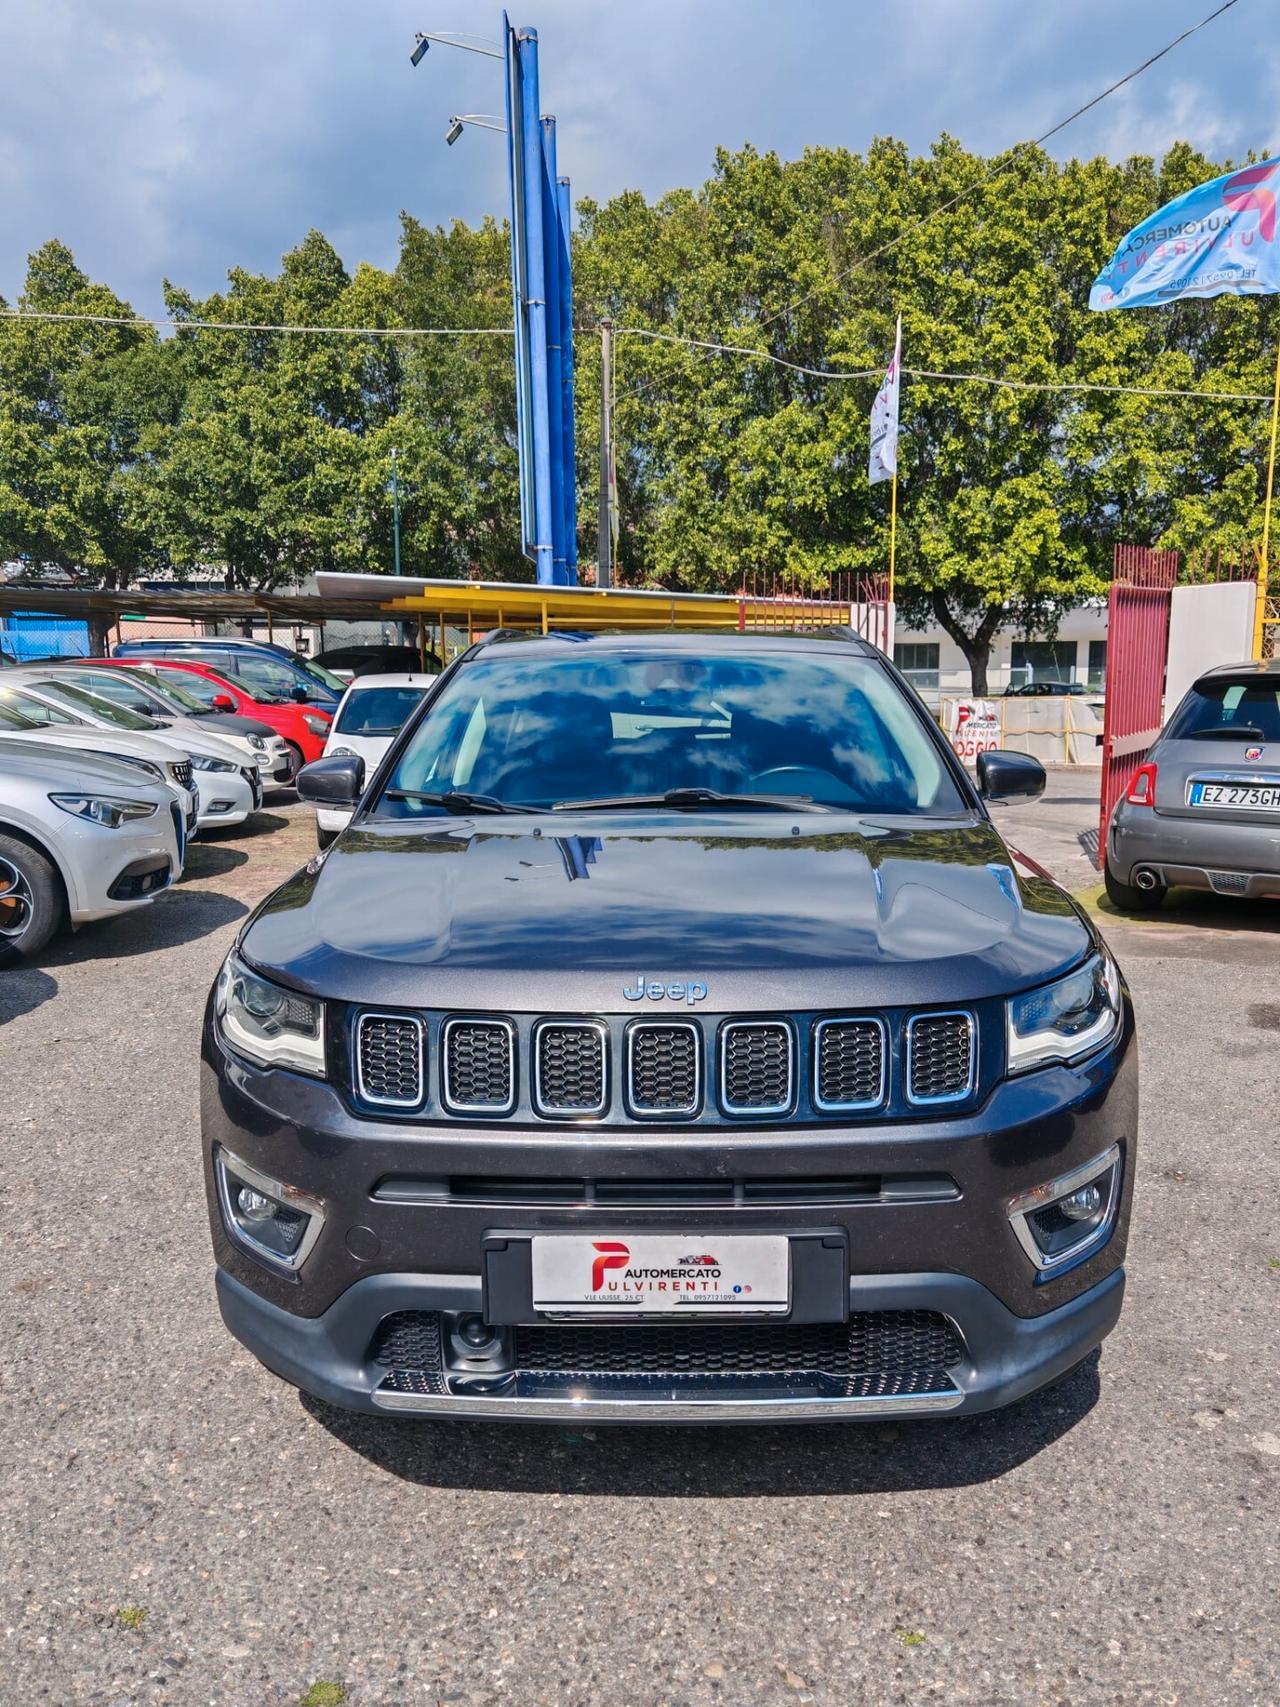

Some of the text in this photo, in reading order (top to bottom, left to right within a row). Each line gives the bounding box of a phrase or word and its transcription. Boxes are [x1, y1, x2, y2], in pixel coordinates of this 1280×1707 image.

[1203, 787, 1224, 803] EZ
[1228, 788, 1280, 806] 273GH
[623, 975, 708, 1006] Jeep
[624, 1268, 722, 1279] AUTOMERCATO
